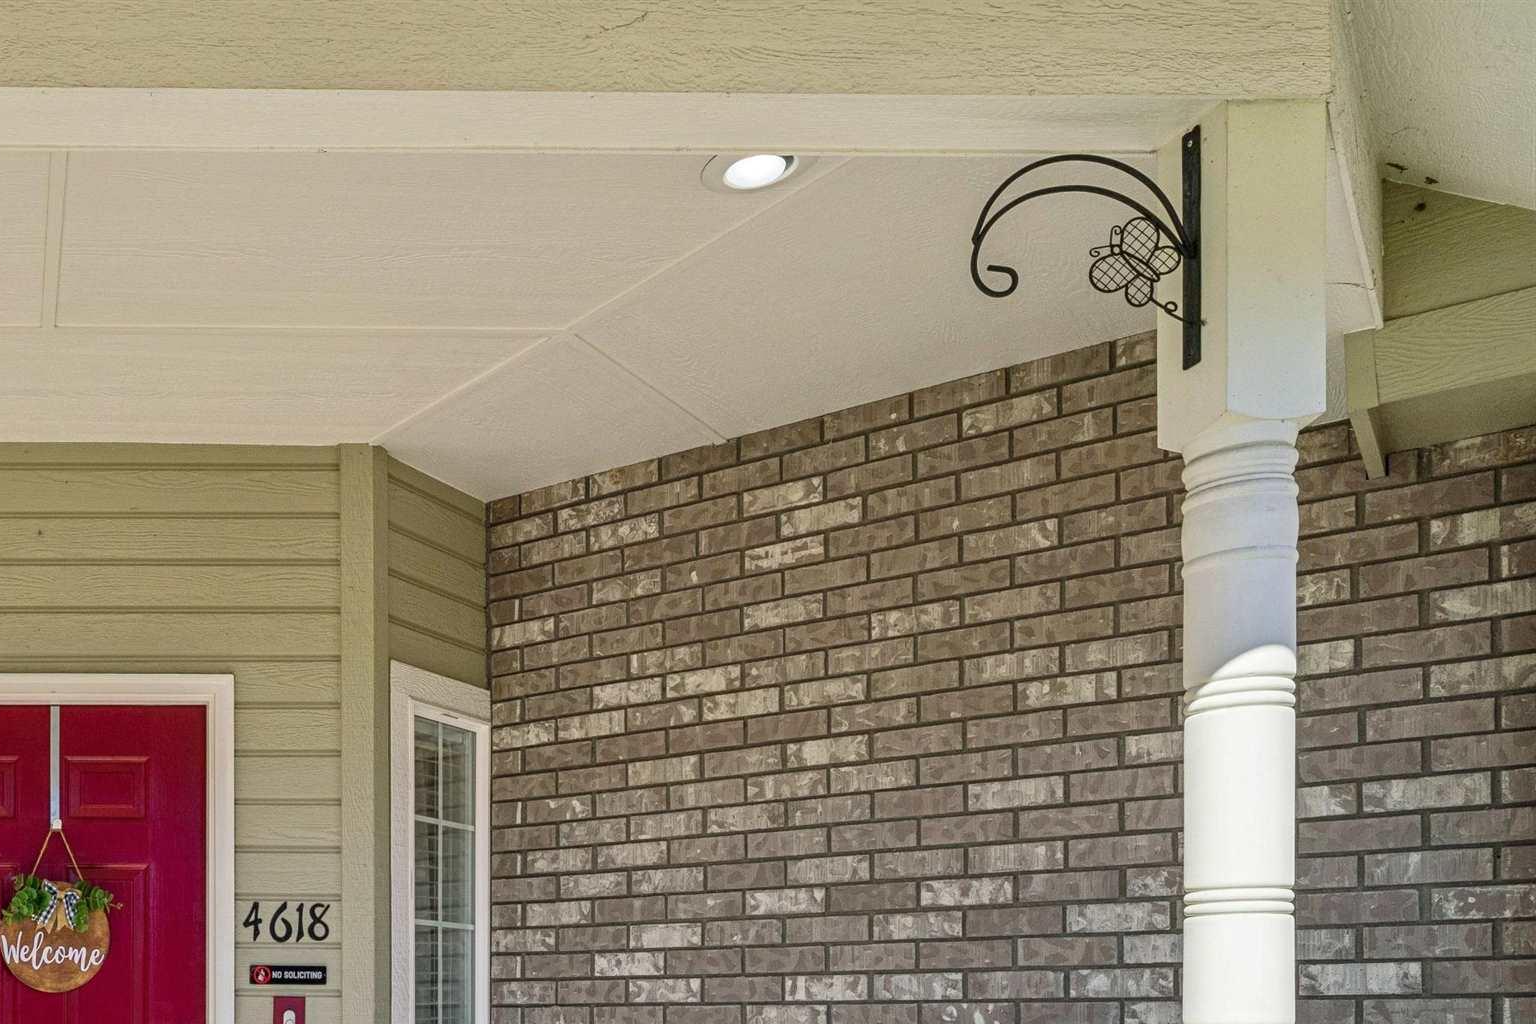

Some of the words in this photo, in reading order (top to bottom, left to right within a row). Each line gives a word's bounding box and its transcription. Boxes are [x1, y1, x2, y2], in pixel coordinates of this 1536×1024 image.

[242, 901, 331, 942] 4618
[0, 931, 105, 972] Welcome
[272, 970, 282, 979] NO
[283, 970, 322, 979] SOLICITING
